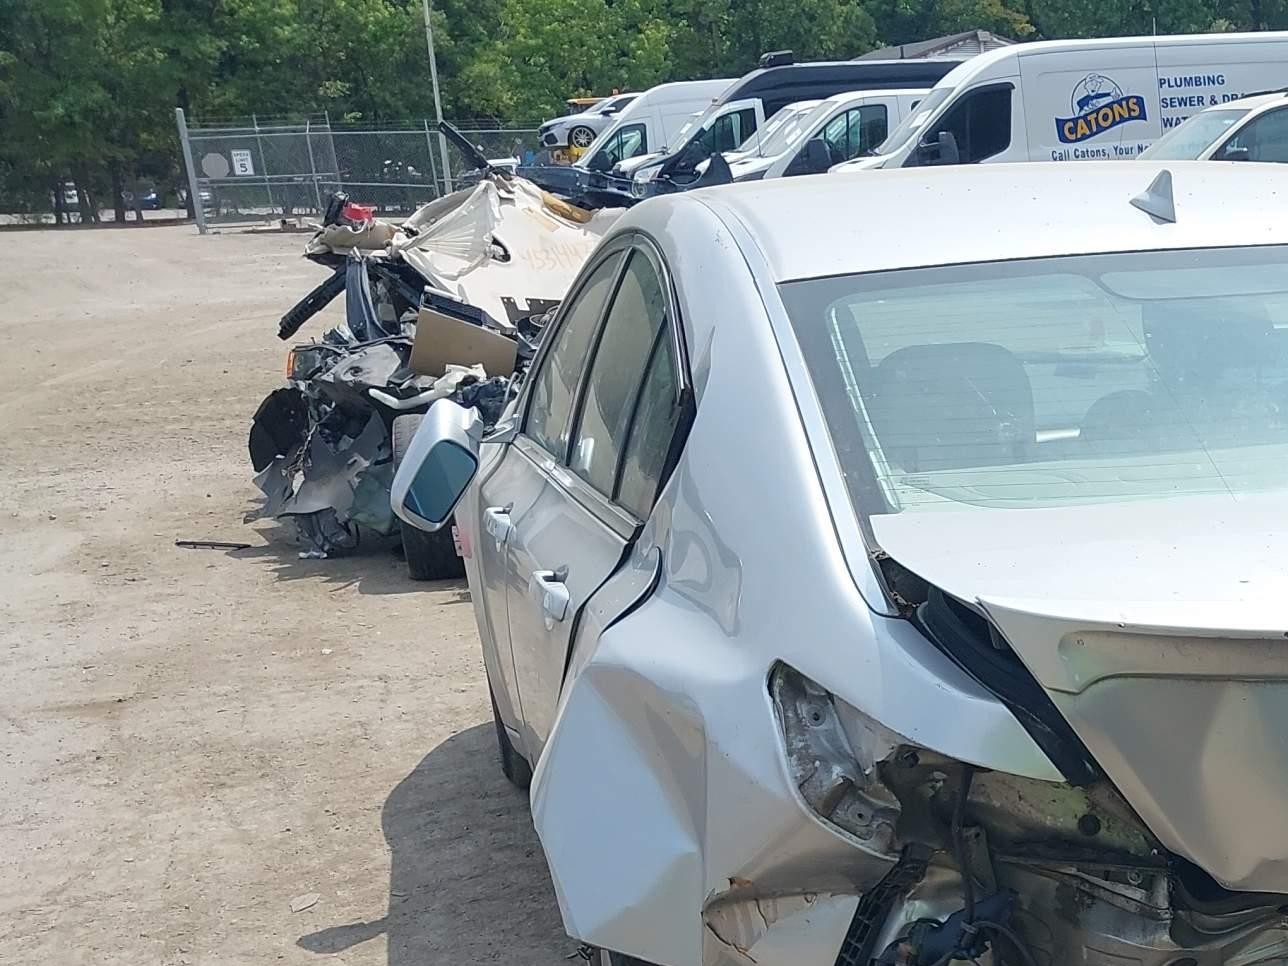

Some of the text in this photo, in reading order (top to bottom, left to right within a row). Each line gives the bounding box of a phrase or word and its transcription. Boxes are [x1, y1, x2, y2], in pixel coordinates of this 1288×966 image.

[1159, 75, 1225, 89] PLUMBING
[1161, 96, 1205, 109] SEWER
[1210, 95, 1218, 106] &
[1063, 98, 1140, 140] CATONS
[1051, 149, 1070, 161] Call
[1073, 148, 1110, 159] Catons,
[1112, 145, 1134, 156] Your
[240, 163, 248, 173] 5
